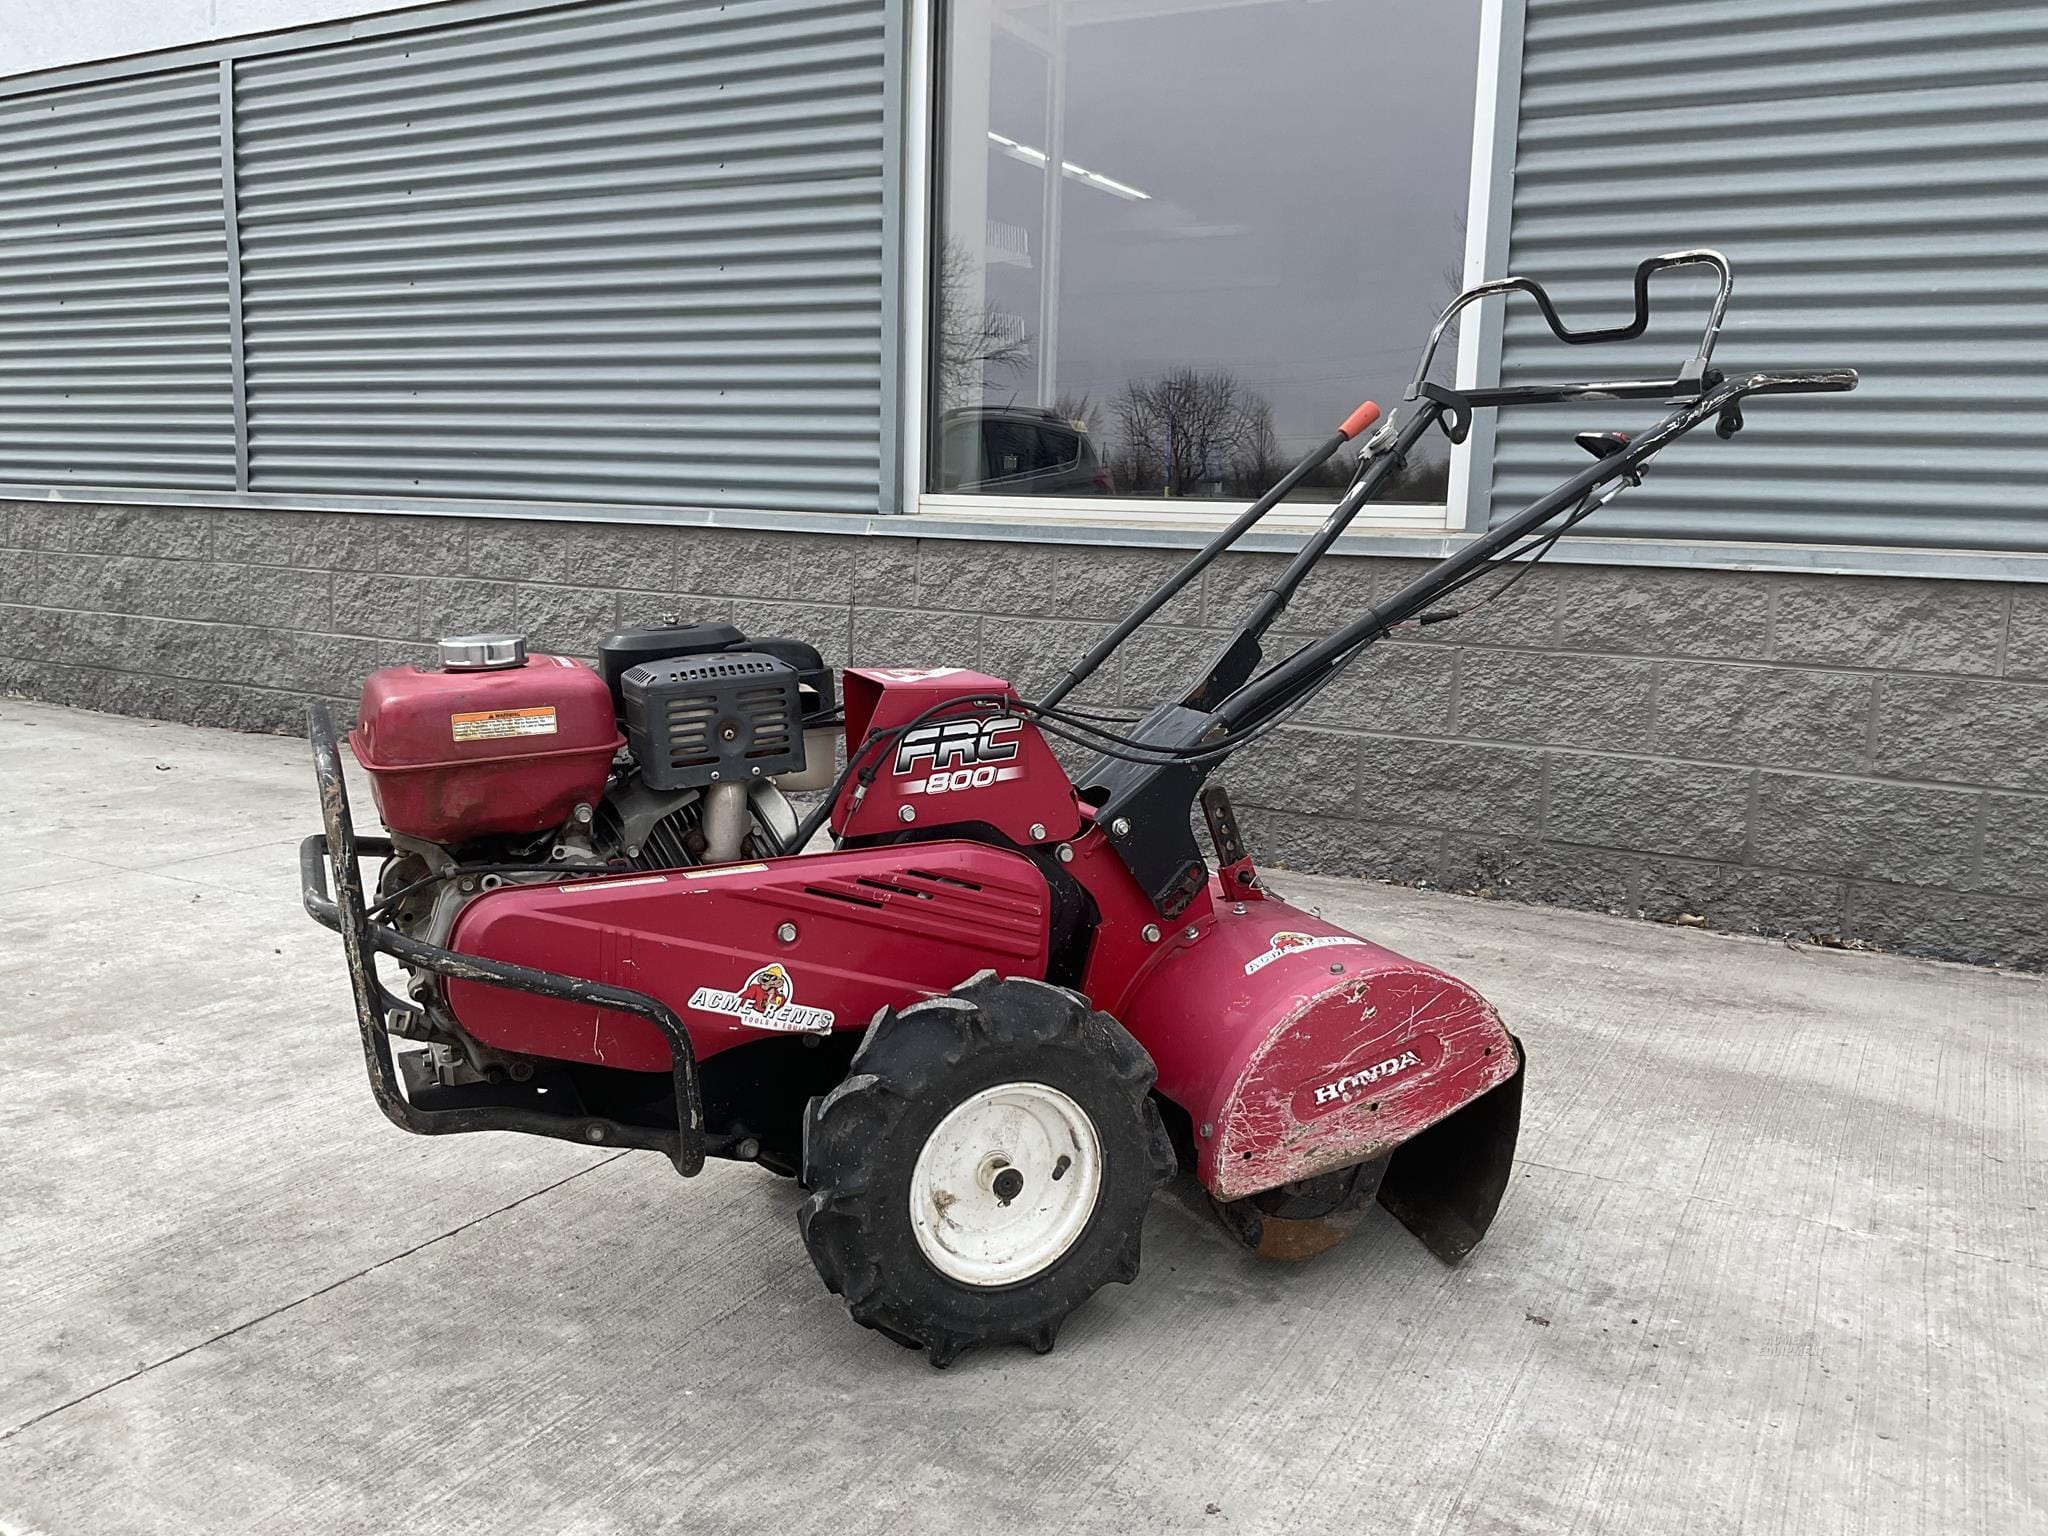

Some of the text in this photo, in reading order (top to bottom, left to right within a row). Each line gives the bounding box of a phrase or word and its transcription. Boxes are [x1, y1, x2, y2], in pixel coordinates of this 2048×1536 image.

[893, 716, 1024, 775] FRC
[926, 766, 998, 795] 800
[692, 990, 833, 1029] ACME RENTS
[743, 1015, 769, 1026] TOOLS
[1313, 1050, 1422, 1106] HONDA
